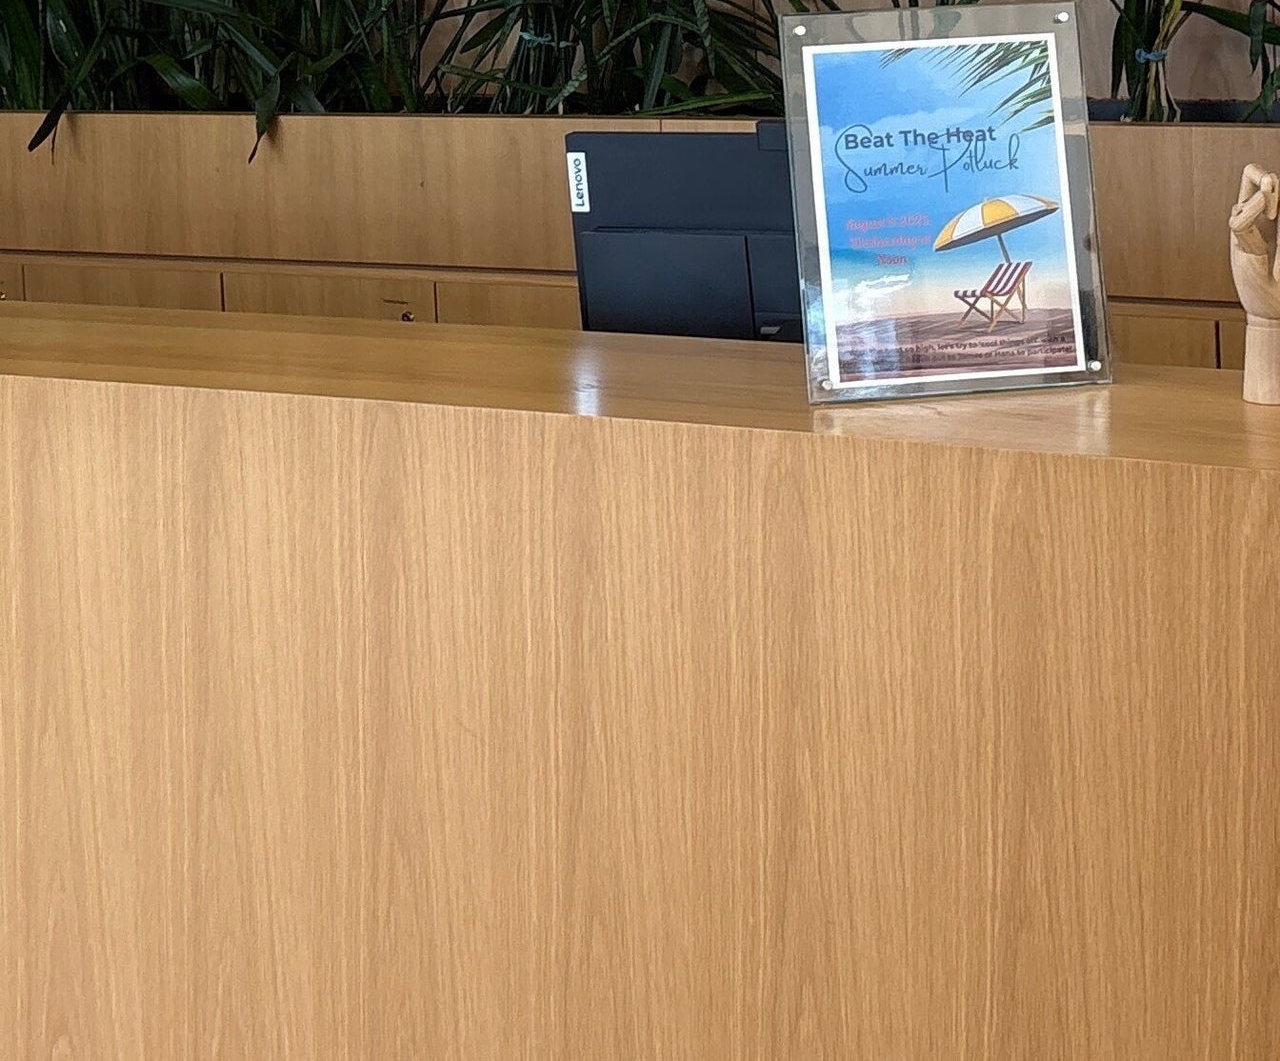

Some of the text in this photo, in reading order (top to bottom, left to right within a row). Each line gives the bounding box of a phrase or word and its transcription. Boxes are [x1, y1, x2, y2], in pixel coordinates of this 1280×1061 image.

[835, 124, 1020, 194] Summer Potluck
[844, 126, 997, 150] Beat The Heat
[573, 158, 585, 207] Lenovo
